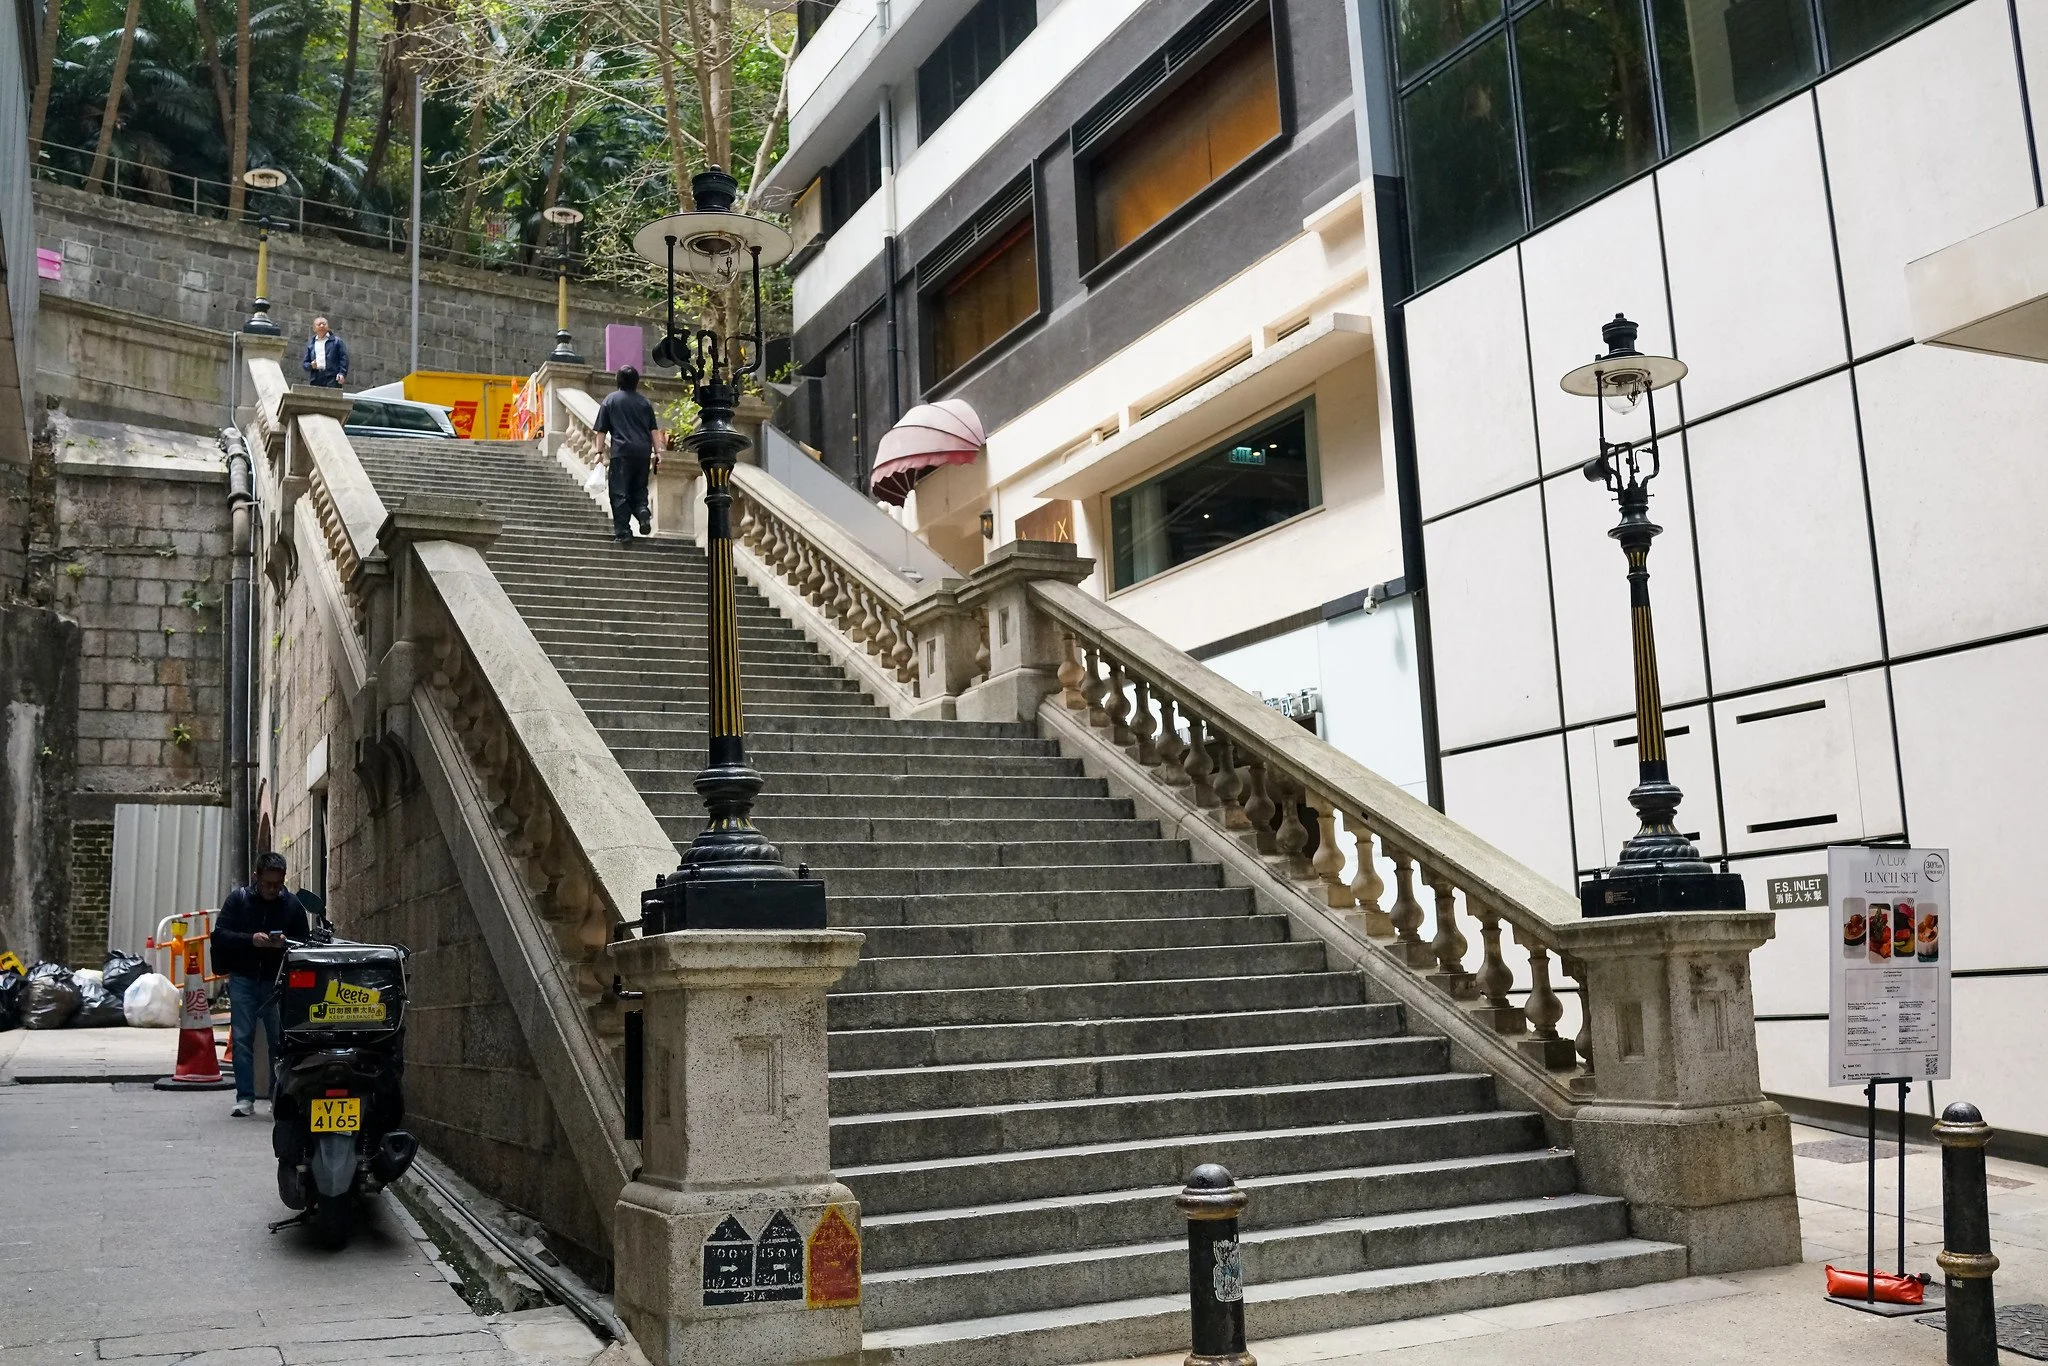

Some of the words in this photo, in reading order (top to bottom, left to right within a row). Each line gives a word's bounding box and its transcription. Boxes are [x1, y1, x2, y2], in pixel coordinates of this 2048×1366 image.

[1864, 872, 1898, 884] LUNCH
[1900, 872, 1919, 884] SET
[1774, 881, 1792, 893] F.S.
[1793, 878, 1821, 891] INLET
[314, 1115, 358, 1129] 4165
